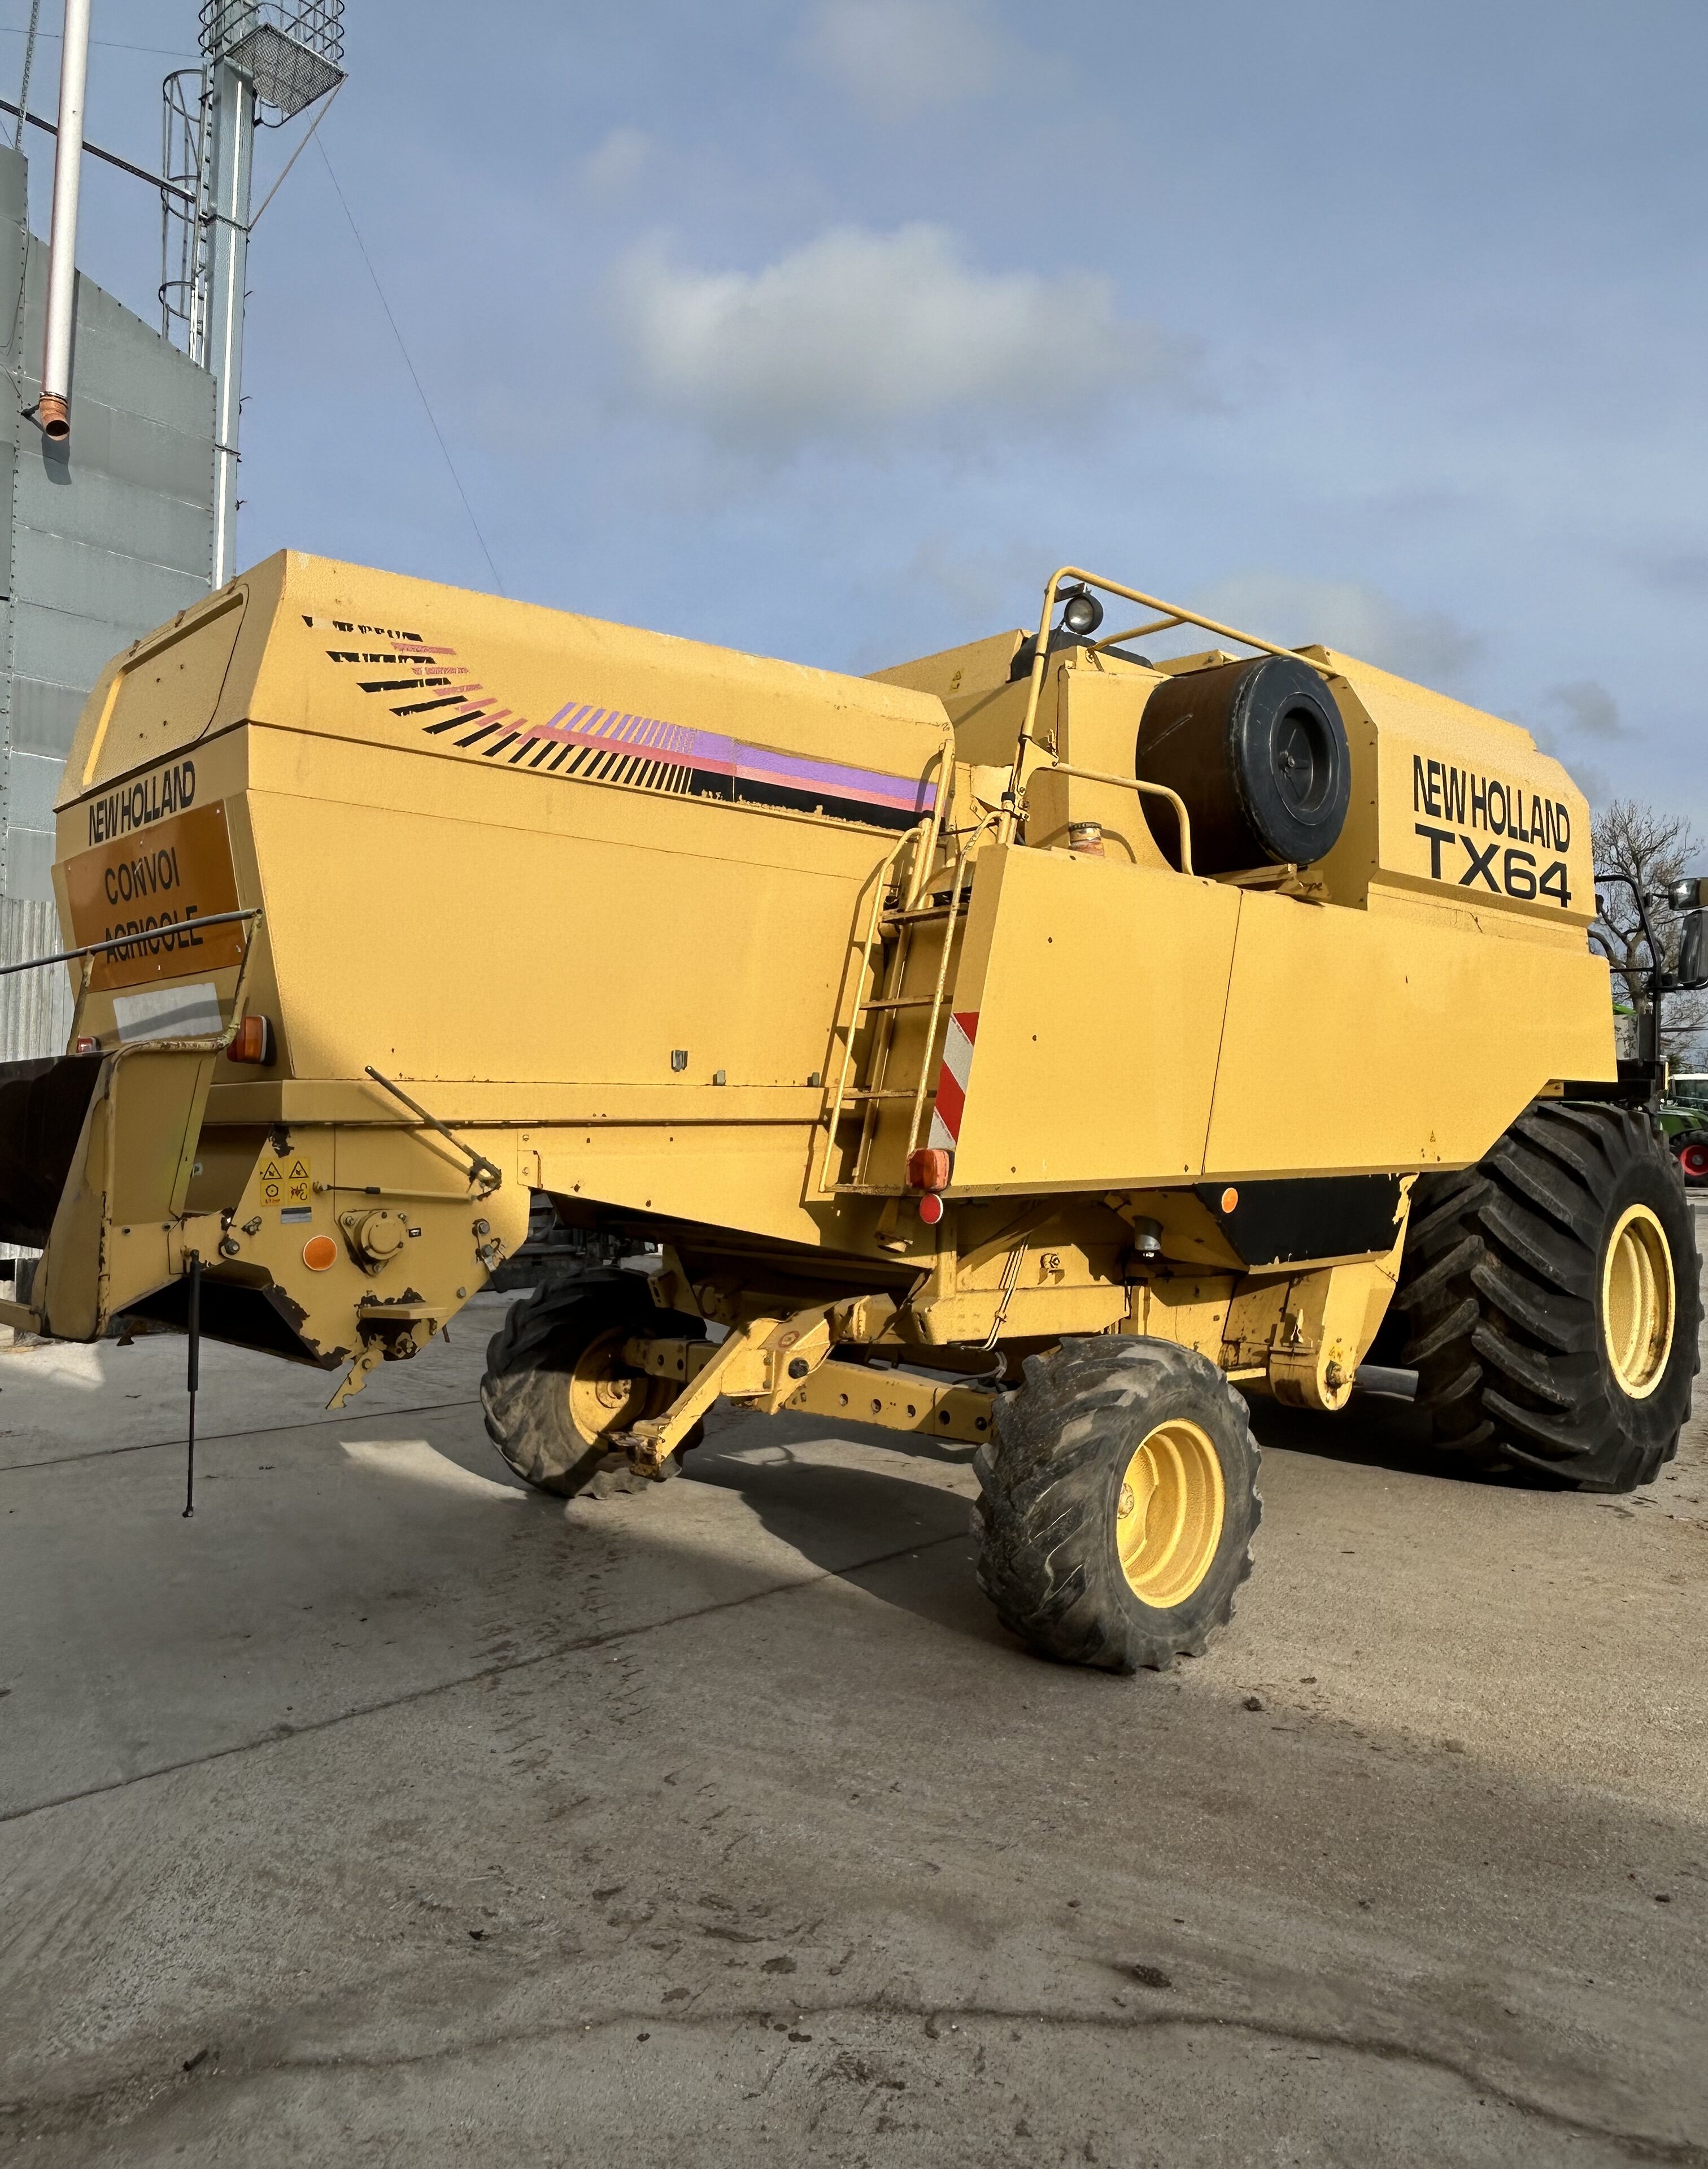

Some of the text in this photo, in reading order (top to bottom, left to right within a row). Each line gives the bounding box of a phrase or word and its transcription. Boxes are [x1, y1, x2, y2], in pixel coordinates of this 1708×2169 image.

[89, 760, 195, 846] NEW HOLLAND
[1413, 754, 1570, 853] NEW HOLLAND
[105, 847, 180, 905] CONVOI
[1415, 823, 1571, 908] TX64
[106, 905, 203, 964] AGRICOLE
